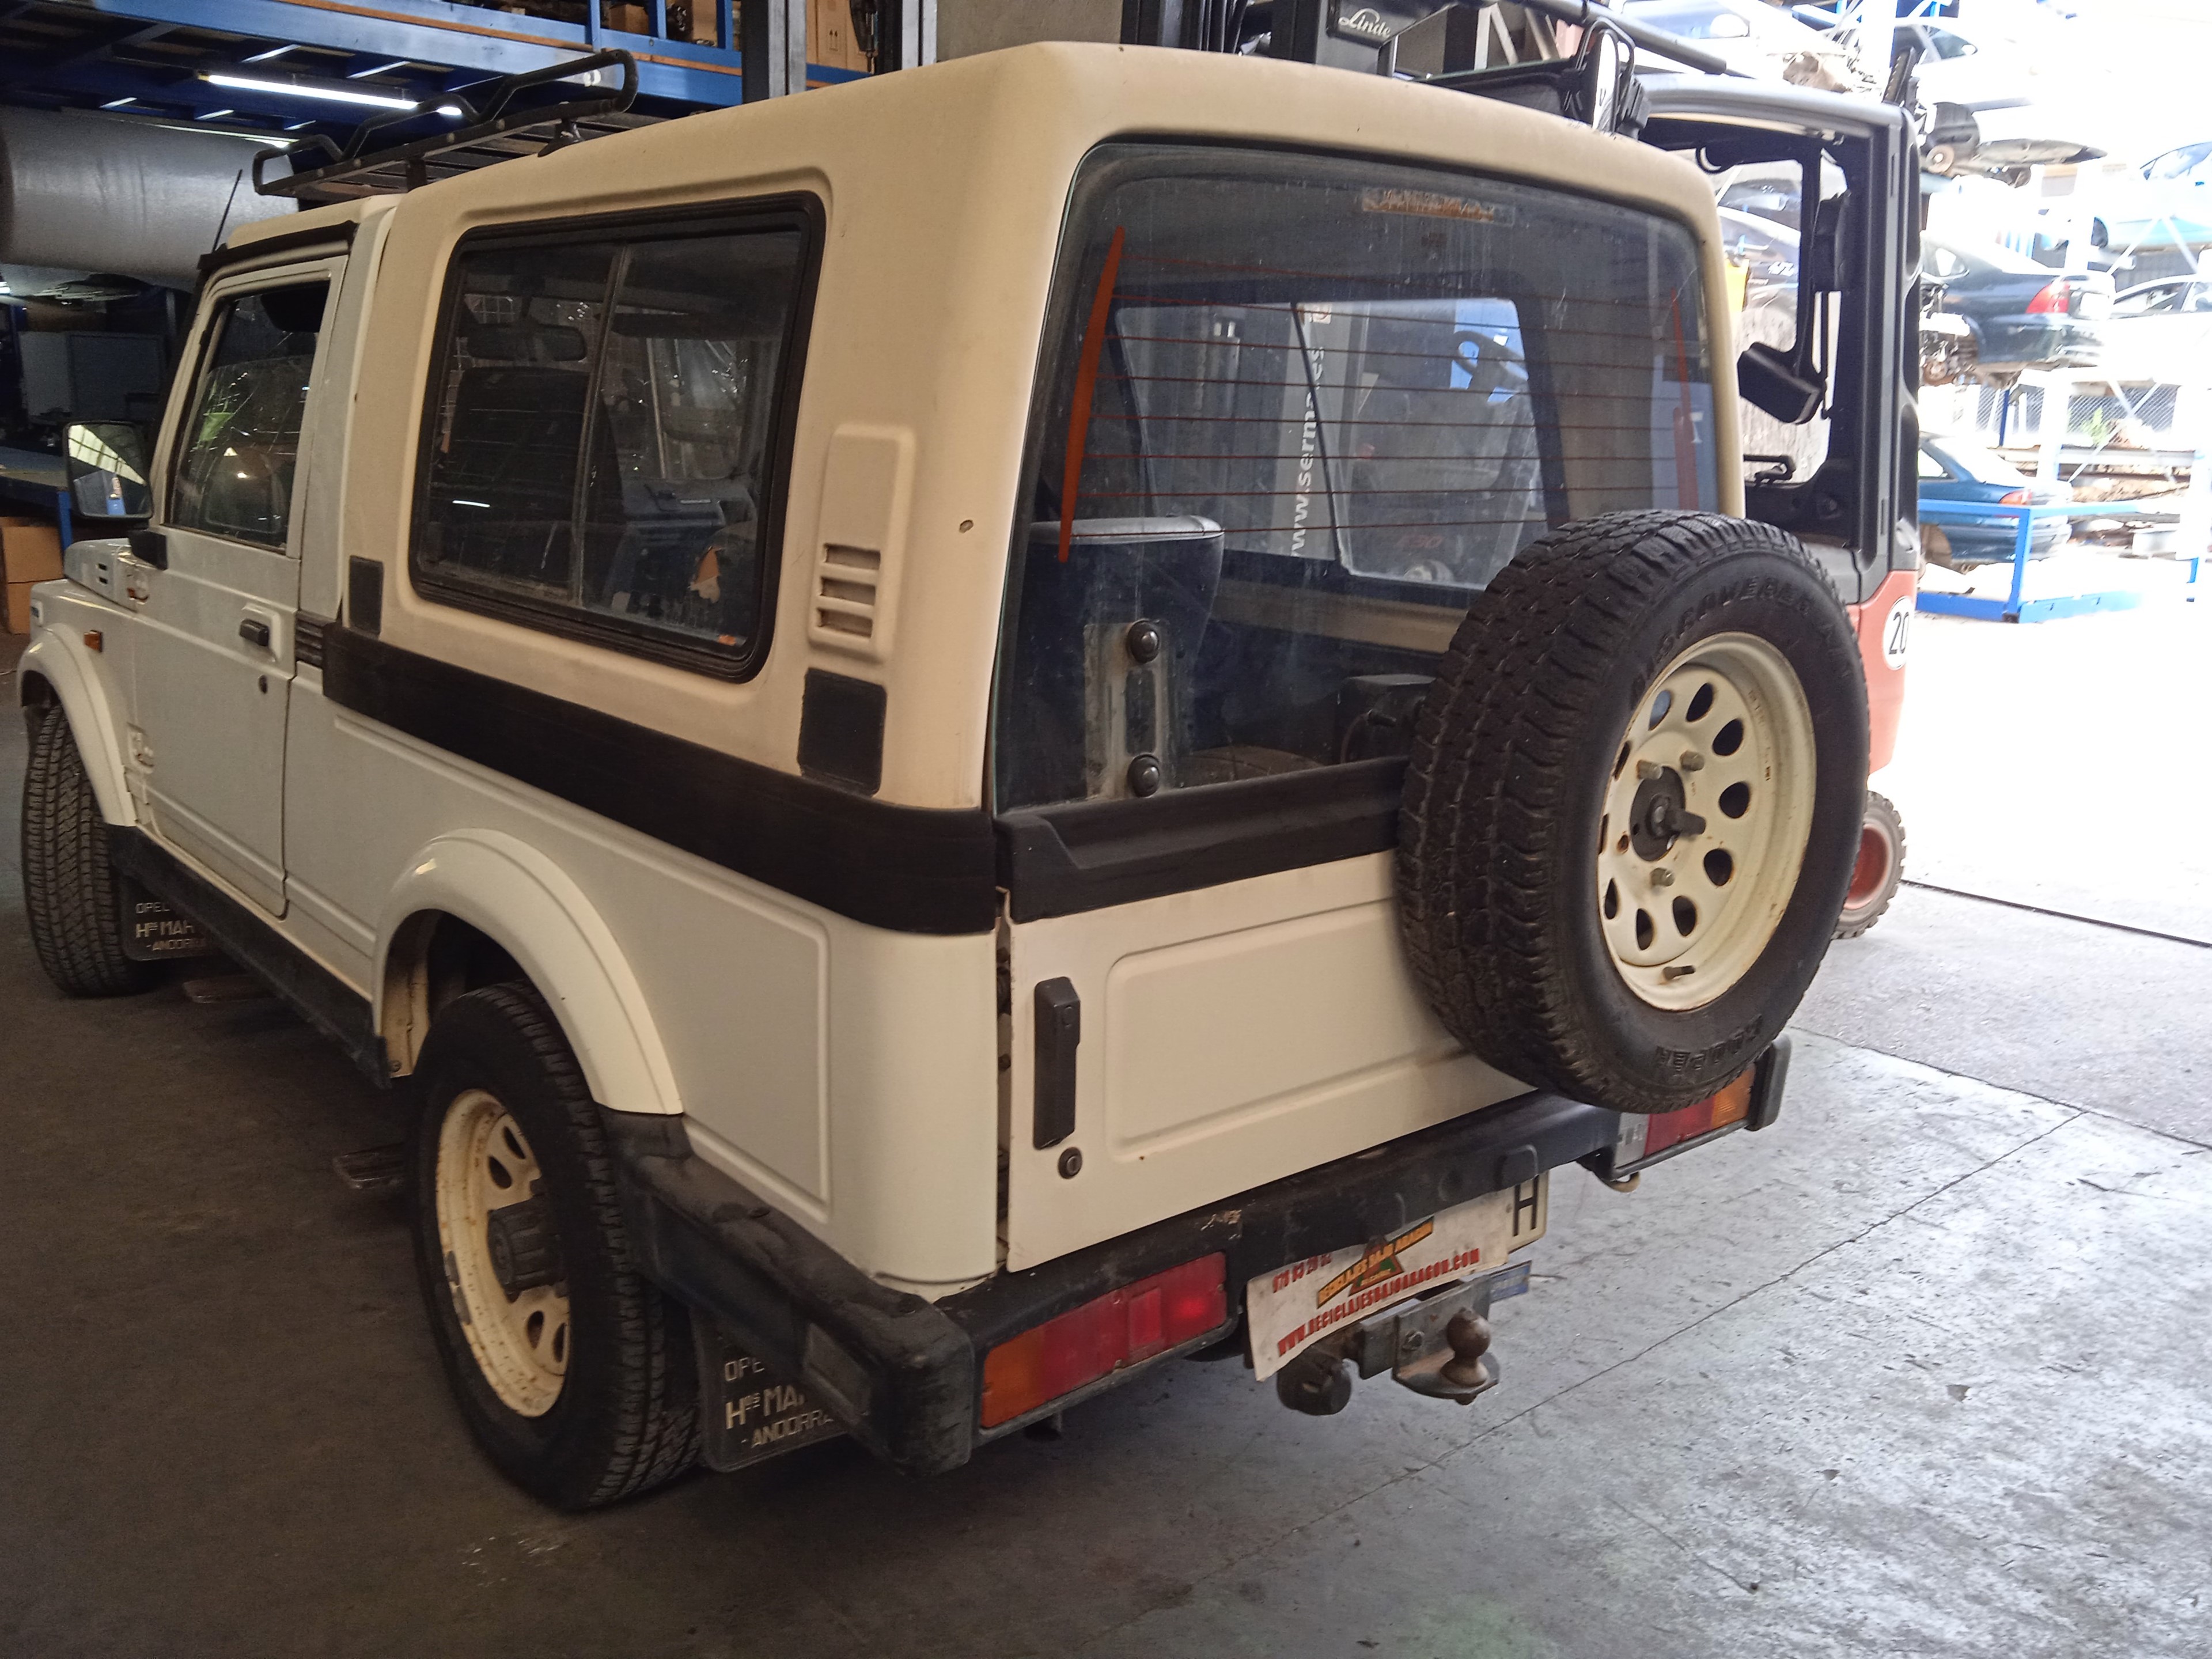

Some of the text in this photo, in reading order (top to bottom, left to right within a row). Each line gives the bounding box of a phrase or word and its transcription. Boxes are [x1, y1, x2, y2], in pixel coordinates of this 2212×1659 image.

[1338, 7, 1390, 38] Linde
[1888, 611, 1910, 655] 20
[1513, 1174, 1538, 1237] H
[724, 1356, 765, 1382] OPE
